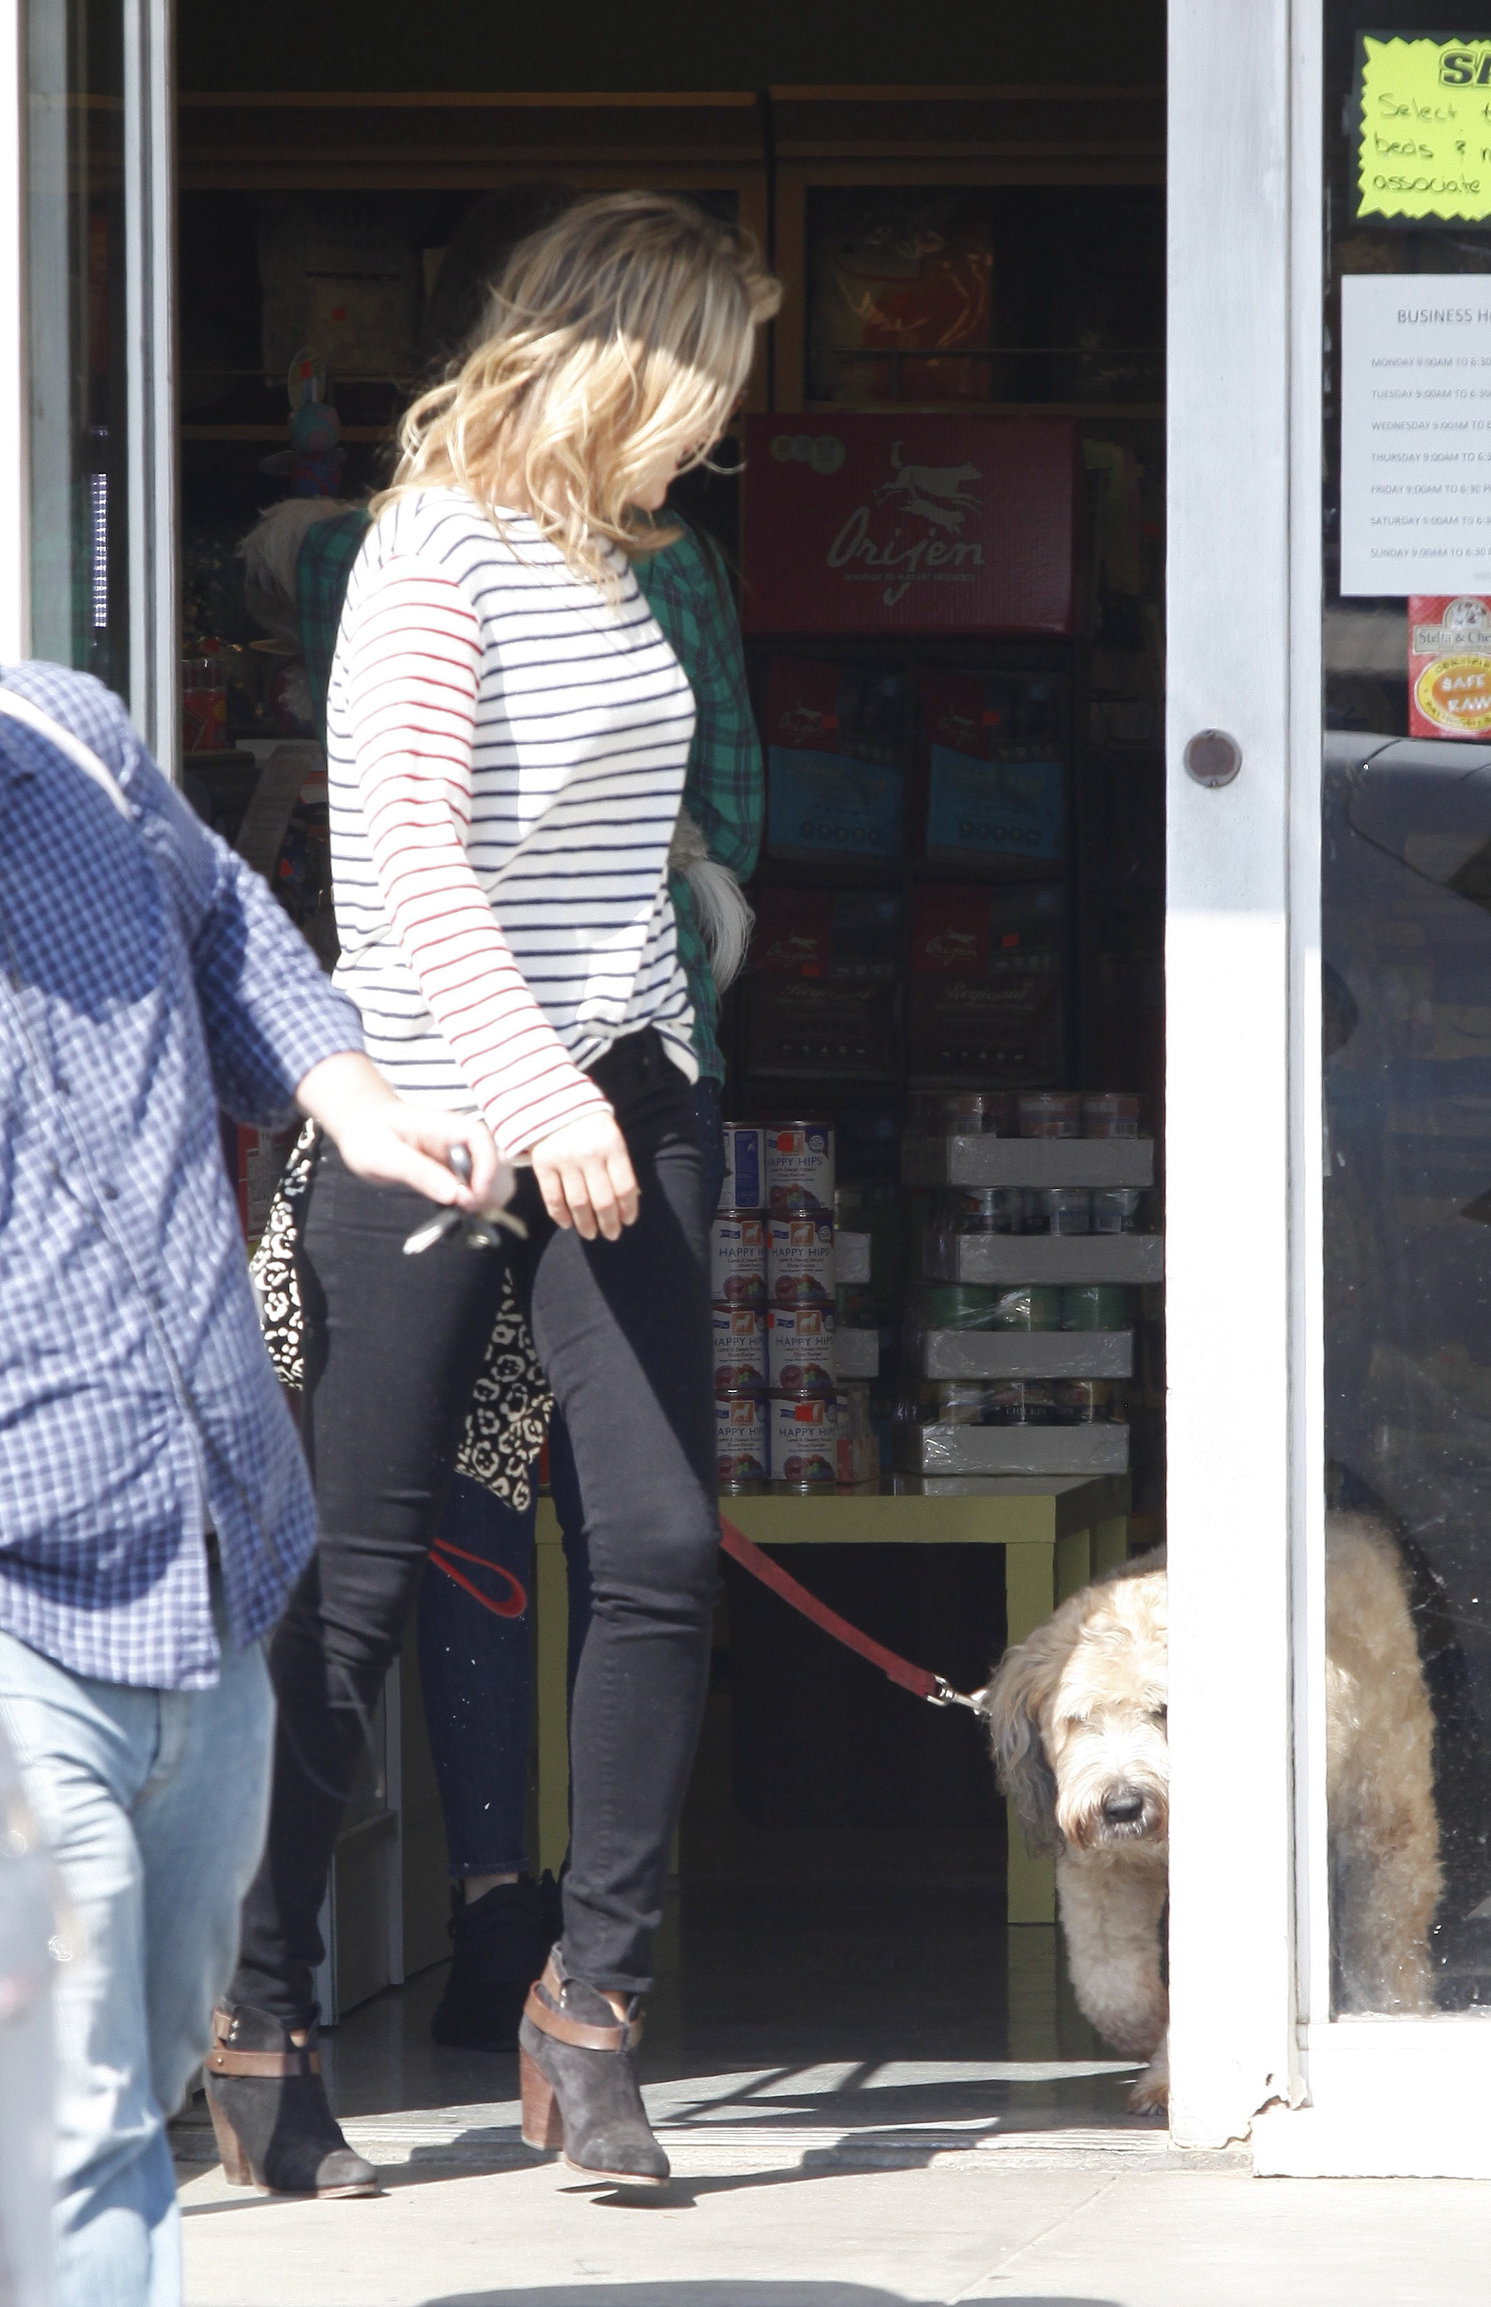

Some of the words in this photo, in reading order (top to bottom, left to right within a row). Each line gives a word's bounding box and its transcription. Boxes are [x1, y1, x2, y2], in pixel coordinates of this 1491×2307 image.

[1378, 92, 1457, 118] Select
[1374, 130, 1434, 158] beds
[1374, 174, 1481, 194] associate
[1397, 308, 1473, 323] BUSINESS
[1478, 308, 1491, 322] H
[1371, 357, 1413, 367] MONDAY
[1456, 357, 1469, 367] TO
[1372, 389, 1413, 399] TUESDAY
[1416, 389, 1452, 399] 9:00AM
[1455, 389, 1467, 399] TO
[1371, 421, 1430, 431] WEDNESDAY
[1472, 421, 1485, 431] TO
[1372, 453, 1421, 463] THURSDAY
[1423, 453, 1459, 463] 9:00AM
[1462, 453, 1475, 463] TO
[1371, 485, 1404, 494] FRIDAY
[1446, 485, 1458, 494] TO
[1370, 516, 1421, 527] SATURDAY
[1462, 516, 1473, 527] TO
[1370, 548, 1410, 558] SUNDAY
[1451, 548, 1464, 558] TO
[1455, 632, 1464, 642] &
[1442, 675, 1486, 692] SAFE
[1448, 695, 1491, 712] RAW
[798, 1156, 823, 1166] HIPS
[719, 1248, 754, 1257] HAPPY
[772, 1248, 803, 1257] HAPPY
[808, 1247, 829, 1256] HIPS
[776, 1336, 811, 1345] HAPPY
[718, 1428, 745, 1436] APPY
[779, 1428, 814, 1436] HAPPY
